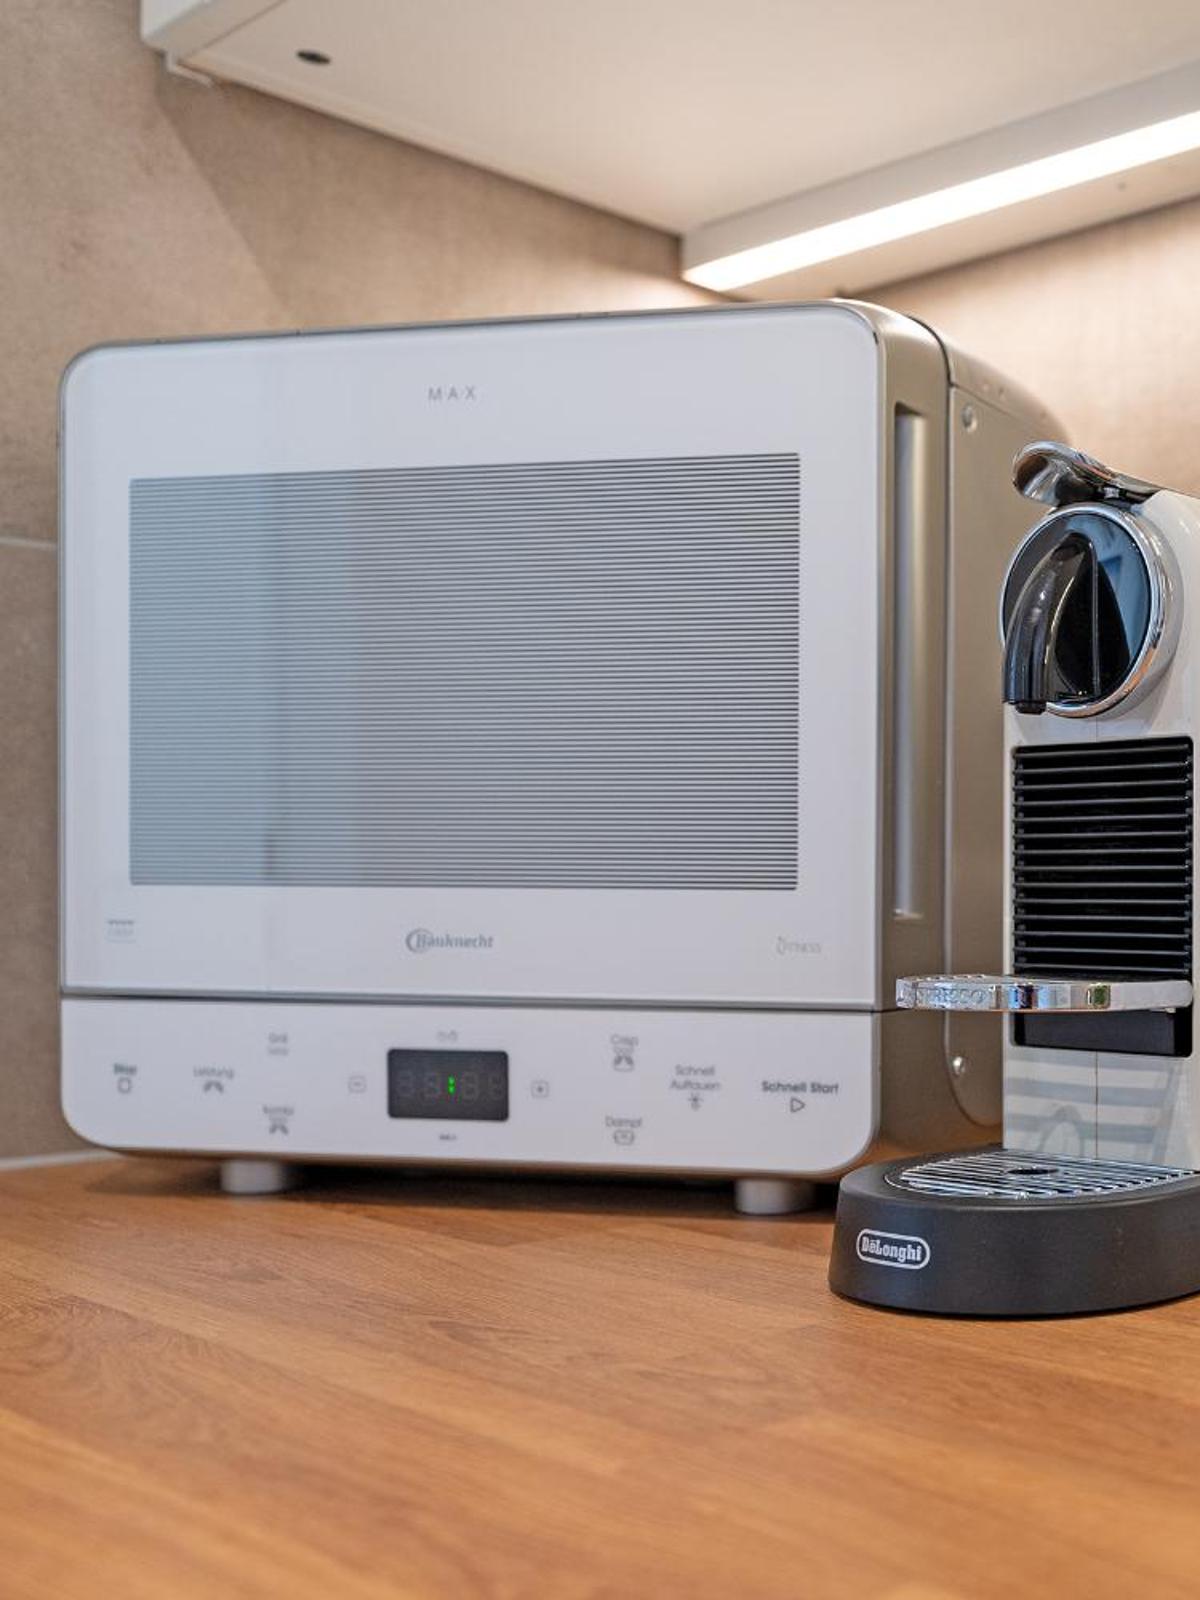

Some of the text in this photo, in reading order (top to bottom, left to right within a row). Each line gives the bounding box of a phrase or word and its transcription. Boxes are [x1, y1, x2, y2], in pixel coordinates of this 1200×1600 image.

[428, 386, 477, 401] MAX
[762, 1081, 839, 1094] Schnell Start
